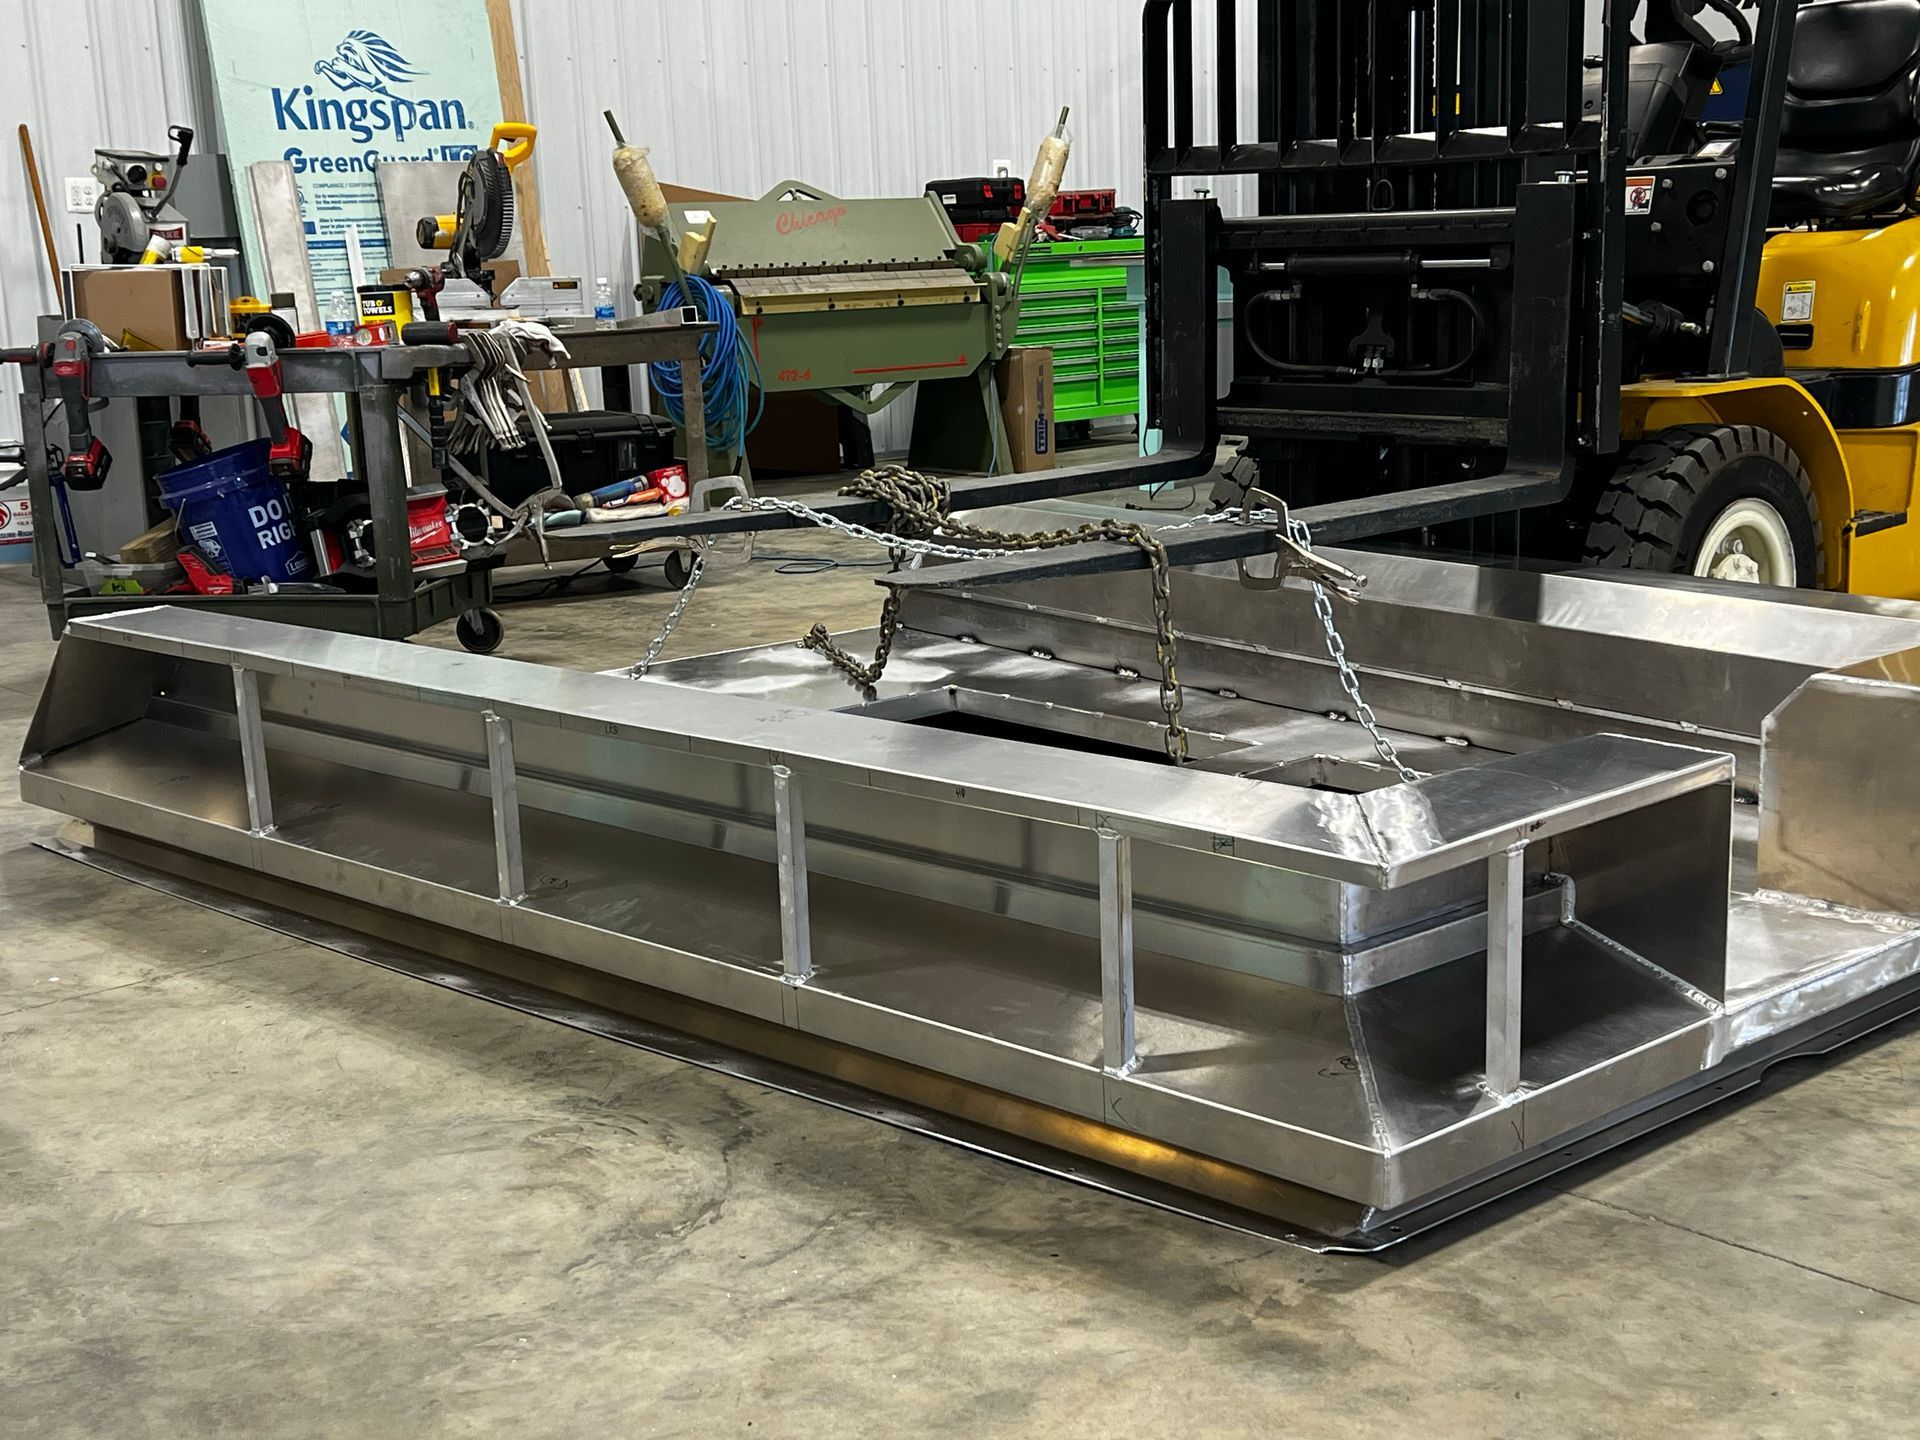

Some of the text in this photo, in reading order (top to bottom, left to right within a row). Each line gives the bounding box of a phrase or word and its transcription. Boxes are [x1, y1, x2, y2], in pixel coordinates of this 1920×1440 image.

[271, 87, 466, 143] Kingspan
[775, 205, 847, 236] Chicago
[362, 299, 375, 307] TUB
[363, 306, 393, 315] TOWELS
[20, 501, 29, 511] 5
[248, 499, 283, 529] DO
